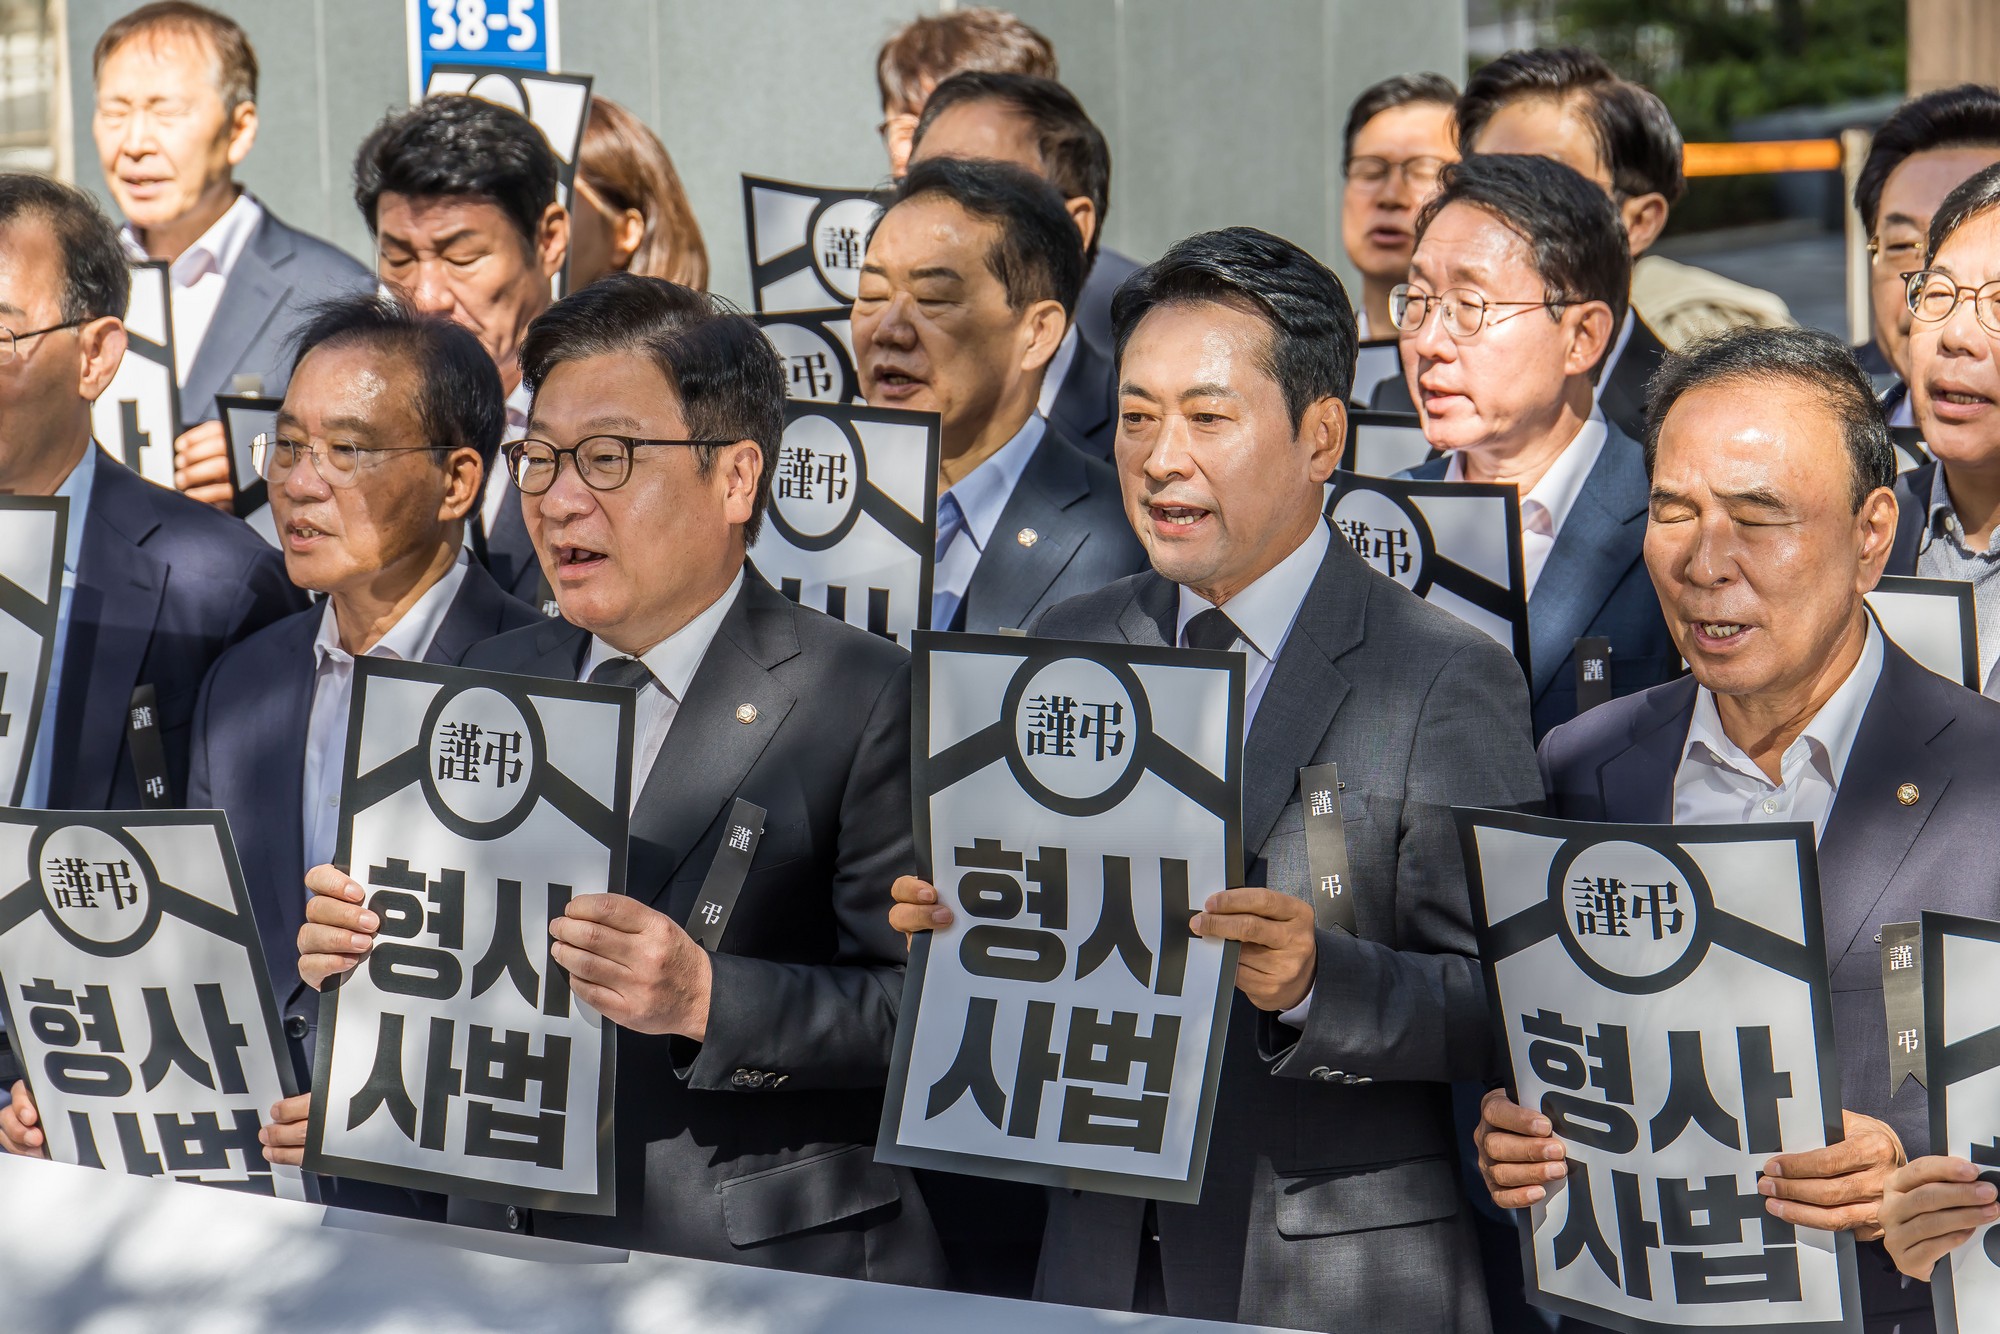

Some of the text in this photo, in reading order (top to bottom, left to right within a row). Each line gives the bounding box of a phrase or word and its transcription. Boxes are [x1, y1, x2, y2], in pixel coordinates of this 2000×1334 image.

[427, 0, 537, 51] 38-5
[821, 227, 860, 269] 謹
[783, 351, 832, 398] 弔
[778, 446, 849, 504] 謹弔
[437, 721, 525, 789] 謹弔
[1025, 695, 1126, 763] 謹弔
[46, 856, 139, 912] 謹弔
[953, 838, 1202, 997] 형사
[1570, 875, 1685, 941] 謹弔
[367, 857, 573, 1019] 형사
[19, 977, 249, 1098] 형사
[346, 1011, 573, 1171] 사법
[924, 996, 1183, 1155] 사법
[1520, 1008, 1793, 1155] 형사
[1552, 1157, 1803, 1305] 사법
